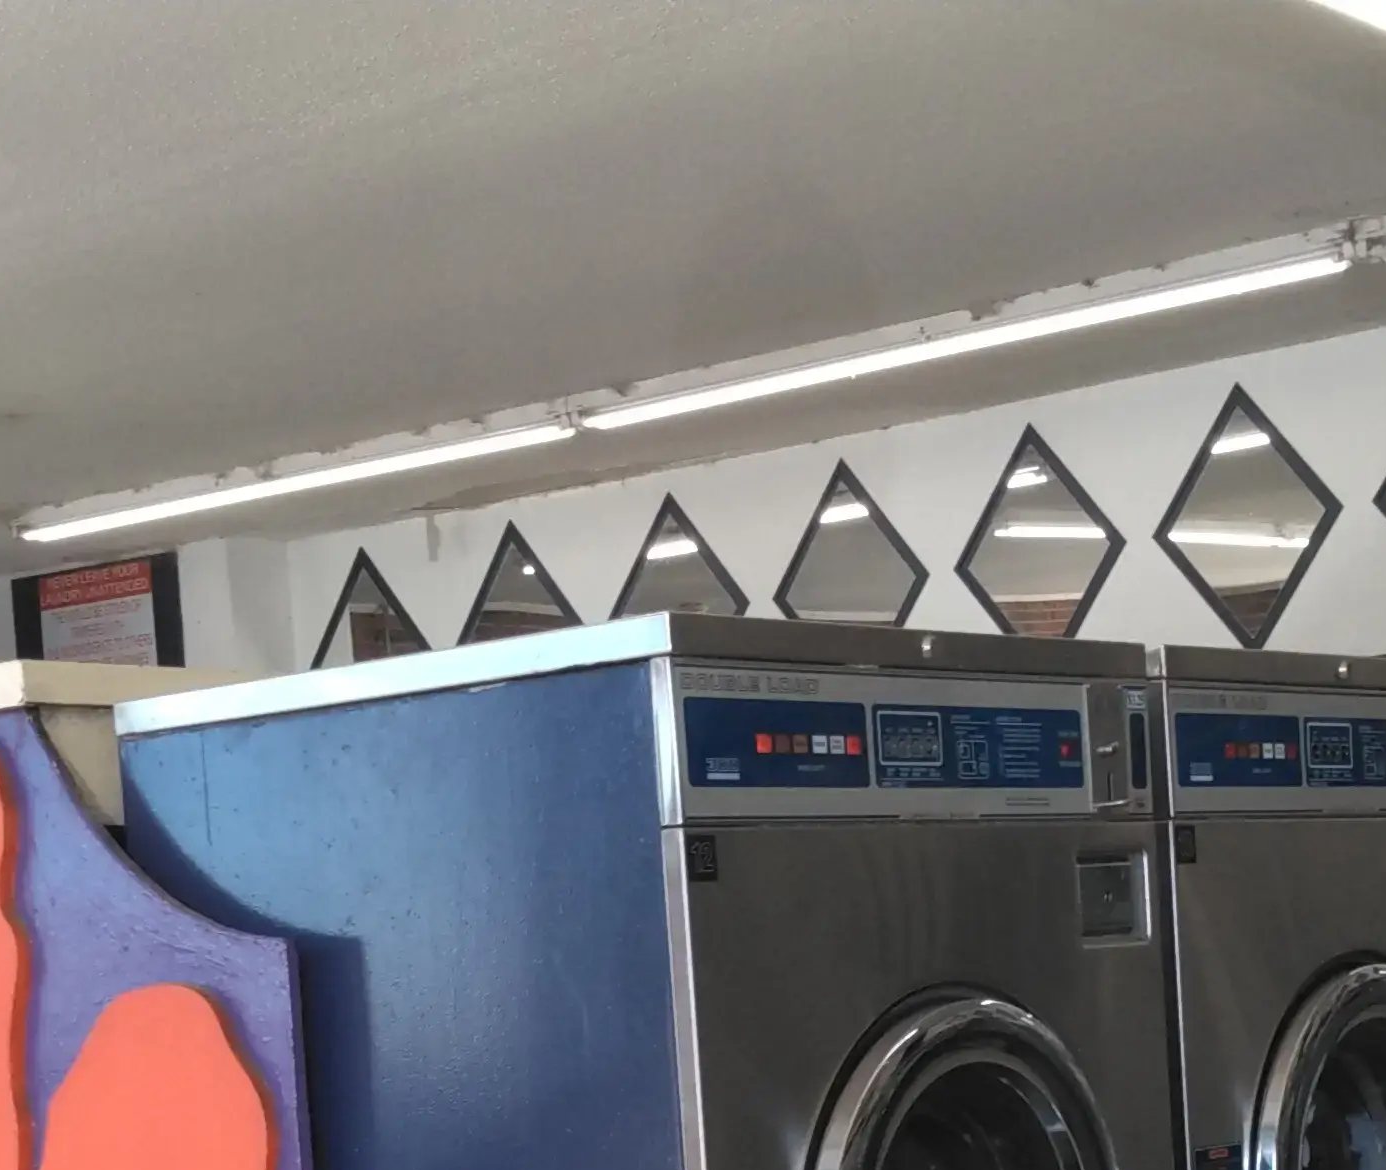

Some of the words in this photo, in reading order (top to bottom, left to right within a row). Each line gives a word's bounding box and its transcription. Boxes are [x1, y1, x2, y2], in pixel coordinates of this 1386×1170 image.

[112, 563, 140, 578] YOUR
[680, 672, 761, 692] DOUBLE
[766, 676, 820, 695] LOAD
